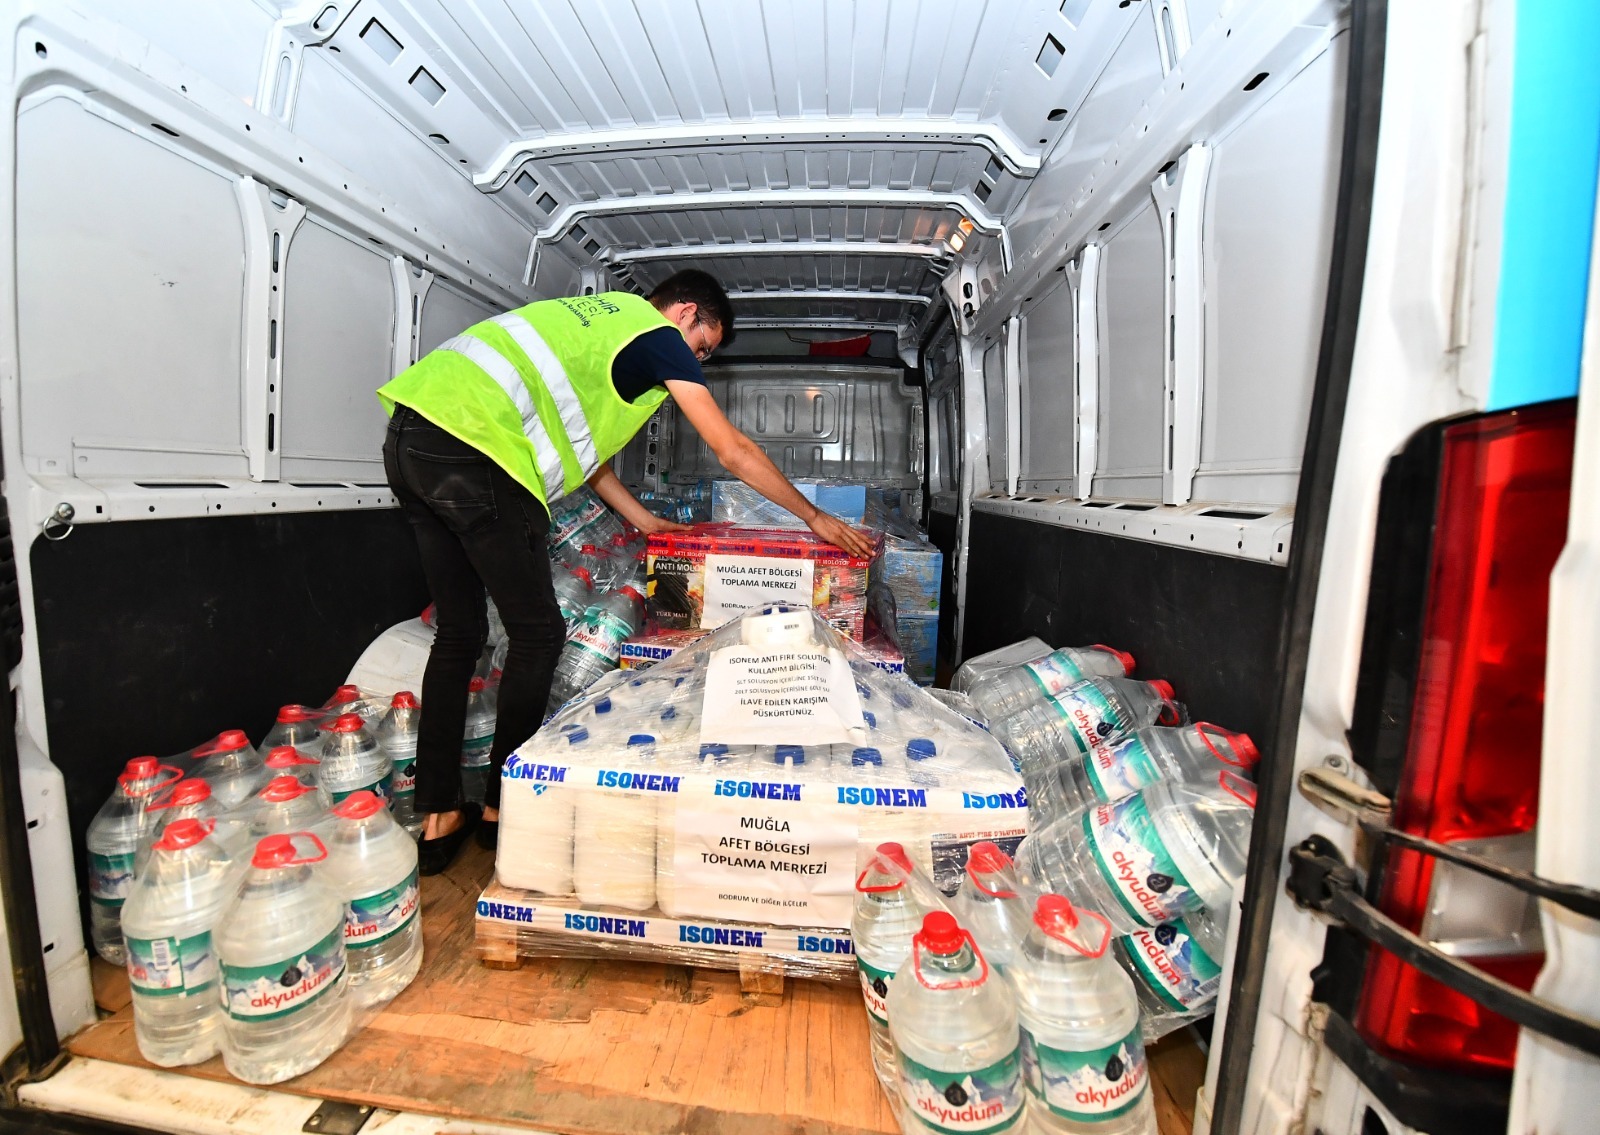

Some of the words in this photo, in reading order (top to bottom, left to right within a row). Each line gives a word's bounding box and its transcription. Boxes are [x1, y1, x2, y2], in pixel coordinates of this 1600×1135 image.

[655, 563, 675, 571] ANTI
[716, 565, 746, 574] MUĞLA
[748, 566, 766, 575] AFET
[769, 567, 803, 578] BÖLGESİ
[721, 578, 759, 588] TOPLAMA
[761, 580, 798, 590] MERKEZİ
[621, 644, 672, 660] ISONEM
[761, 655, 778, 663] ANTI
[797, 654, 831, 665] SOLUTION
[748, 666, 788, 674] KULLANIM
[740, 697, 763, 706] İLAVE
[764, 698, 791, 706] EDİLEN
[753, 708, 815, 717] PÜSKÜRTÜNÜZ.
[596, 769, 681, 792] ISONEM
[714, 779, 803, 801] ISONEM
[837, 786, 928, 808] ISONEM
[740, 816, 791, 833] MUĞLA
[719, 836, 751, 850] AFET
[755, 839, 811, 856] BÖLGESİ
[701, 852, 767, 870] TOPLAMA
[770, 860, 828, 875] MERKEZİ
[1112, 851, 1168, 922] akyudum
[718, 893, 750, 902] BODRUM
[761, 897, 781, 907] DİĞER
[783, 900, 808, 908] İLÇELER
[564, 913, 646, 938] ISONEM
[679, 925, 763, 948] ISONEM
[250, 967, 332, 1009] akyudum
[917, 1098, 1003, 1123] akyudum
